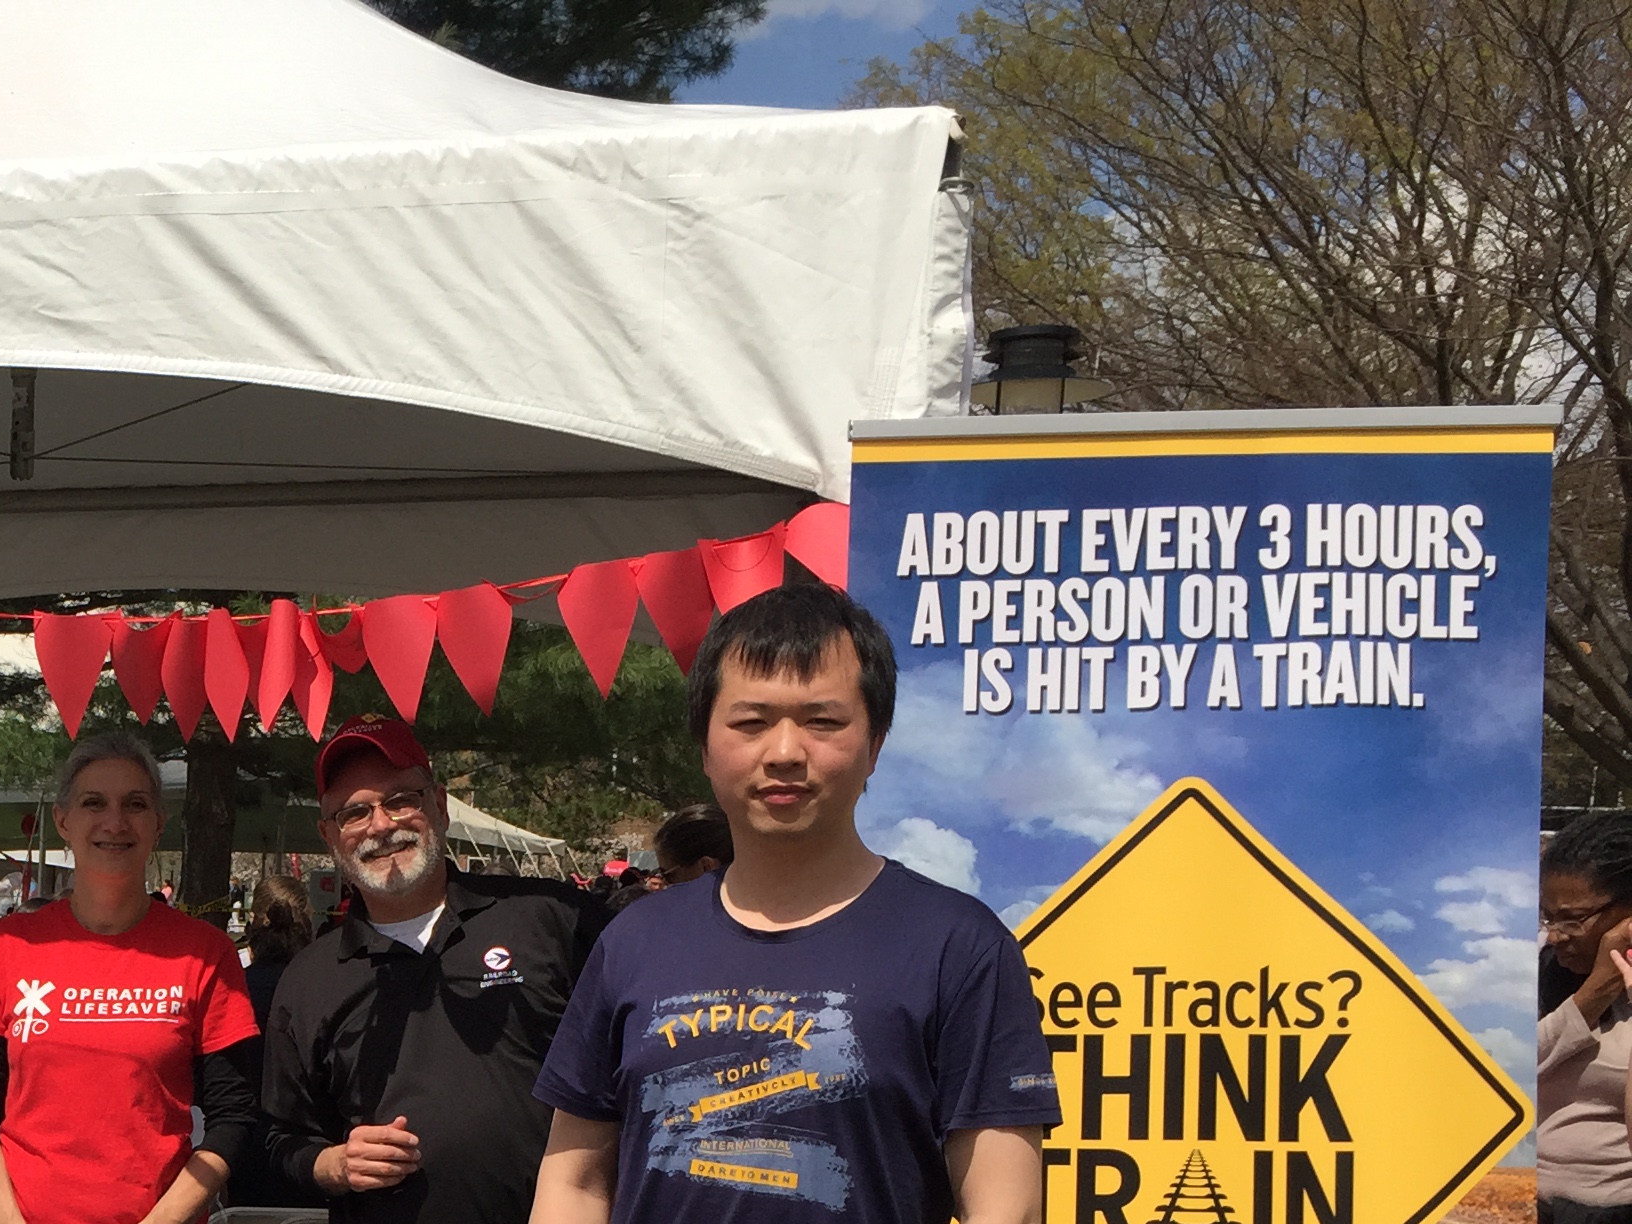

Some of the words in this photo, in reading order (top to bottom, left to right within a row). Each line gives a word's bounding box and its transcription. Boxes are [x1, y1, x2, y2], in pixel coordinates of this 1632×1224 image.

[897, 510, 1070, 578] ABOUT
[1080, 505, 1248, 573] EVERY
[1257, 504, 1292, 571] 3
[1306, 503, 1497, 577] HOURS,
[911, 582, 945, 646] A
[958, 576, 1165, 645] PERSON
[1178, 575, 1249, 641] OR
[1262, 572, 1480, 640] VEHICLE
[963, 648, 1013, 714] IS
[1026, 646, 1115, 713] HIT
[1126, 644, 1199, 710] BY
[1207, 645, 1241, 708] A
[1254, 642, 1425, 710] TRAIN.
[61, 1001, 181, 1015] LIFESAVER
[64, 985, 183, 1000] OPERATION
[1133, 965, 1363, 1029] Tracks?
[658, 1003, 814, 1051] TYPICAL
[714, 1057, 771, 1086] TOPIC
[700, 1138, 791, 1150] INTERNATIONAL
